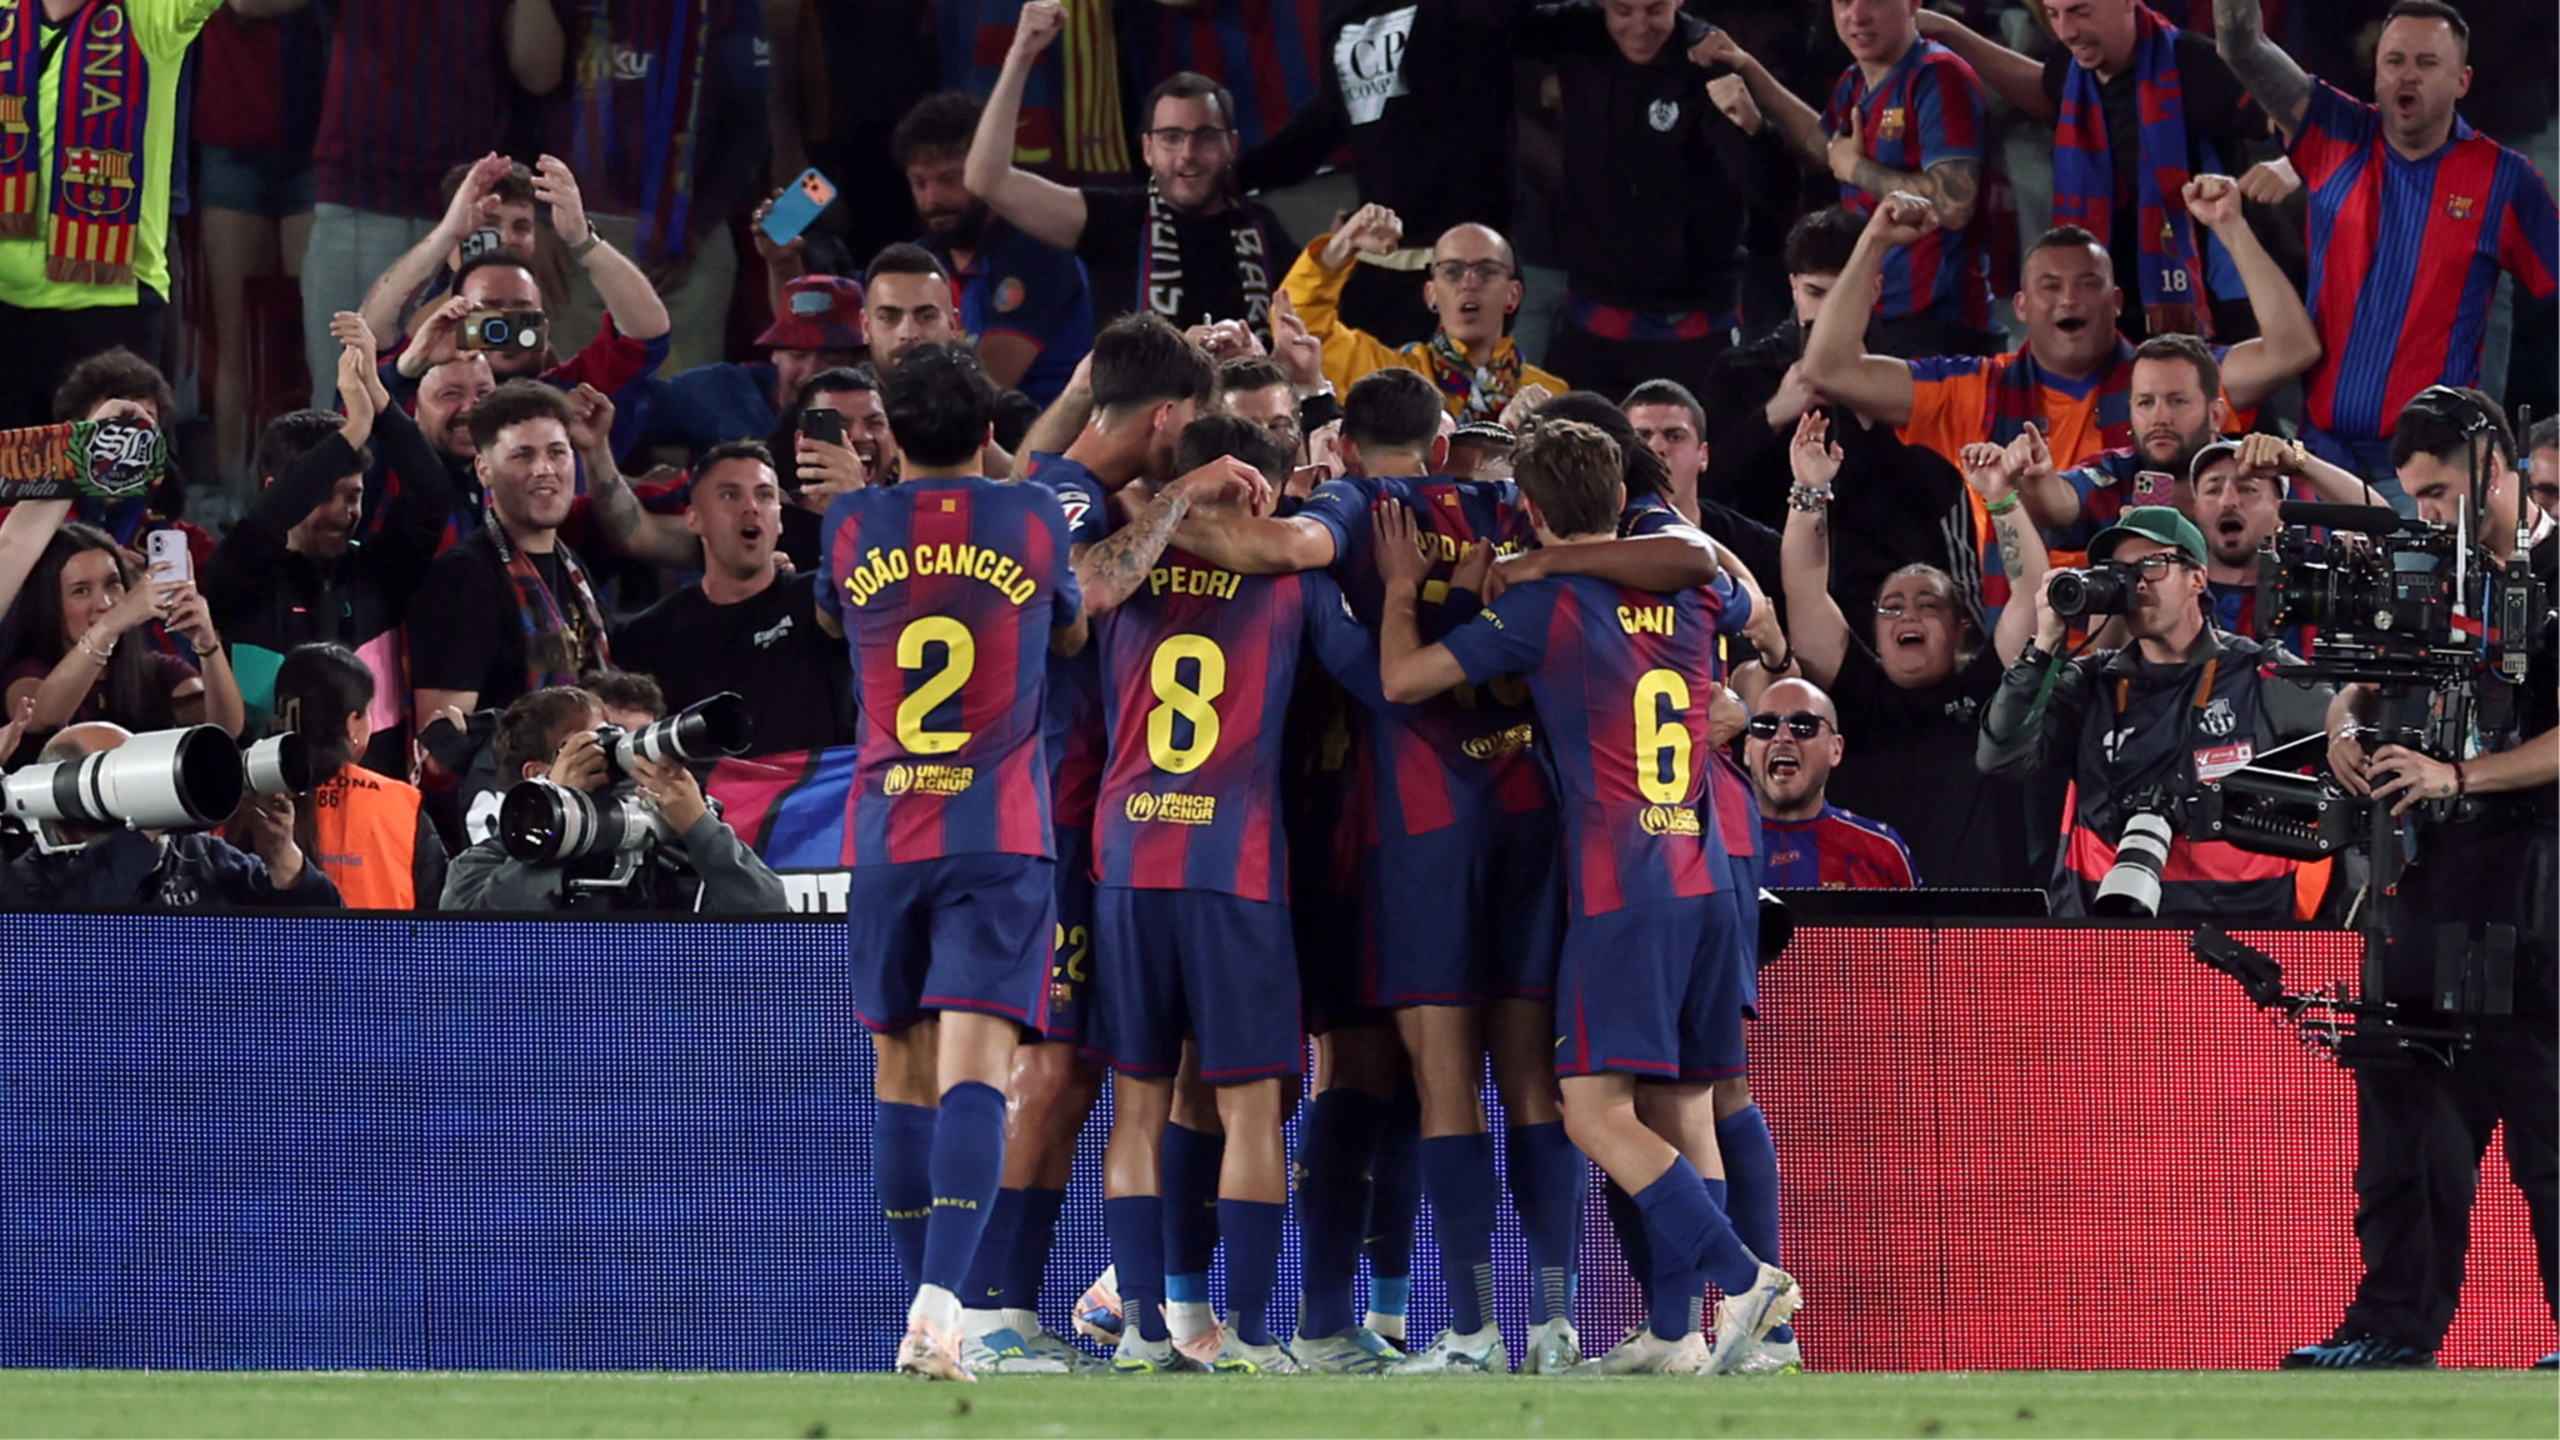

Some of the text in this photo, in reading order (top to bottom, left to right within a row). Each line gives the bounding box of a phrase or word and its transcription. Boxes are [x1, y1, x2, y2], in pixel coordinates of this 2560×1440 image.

[2161, 269, 2188, 292] 18
[844, 543, 1037, 607] JOÃO CANCELO
[1149, 566, 1241, 600] PEDRI
[1616, 605, 1675, 636] GAVI
[896, 615, 976, 755] 2
[1147, 633, 1226, 774] 8
[1633, 668, 1692, 805] 6
[916, 765, 974, 780] UNHCR
[1158, 804, 1214, 820] ACNUR
[1162, 792, 1216, 808] UNHCR
